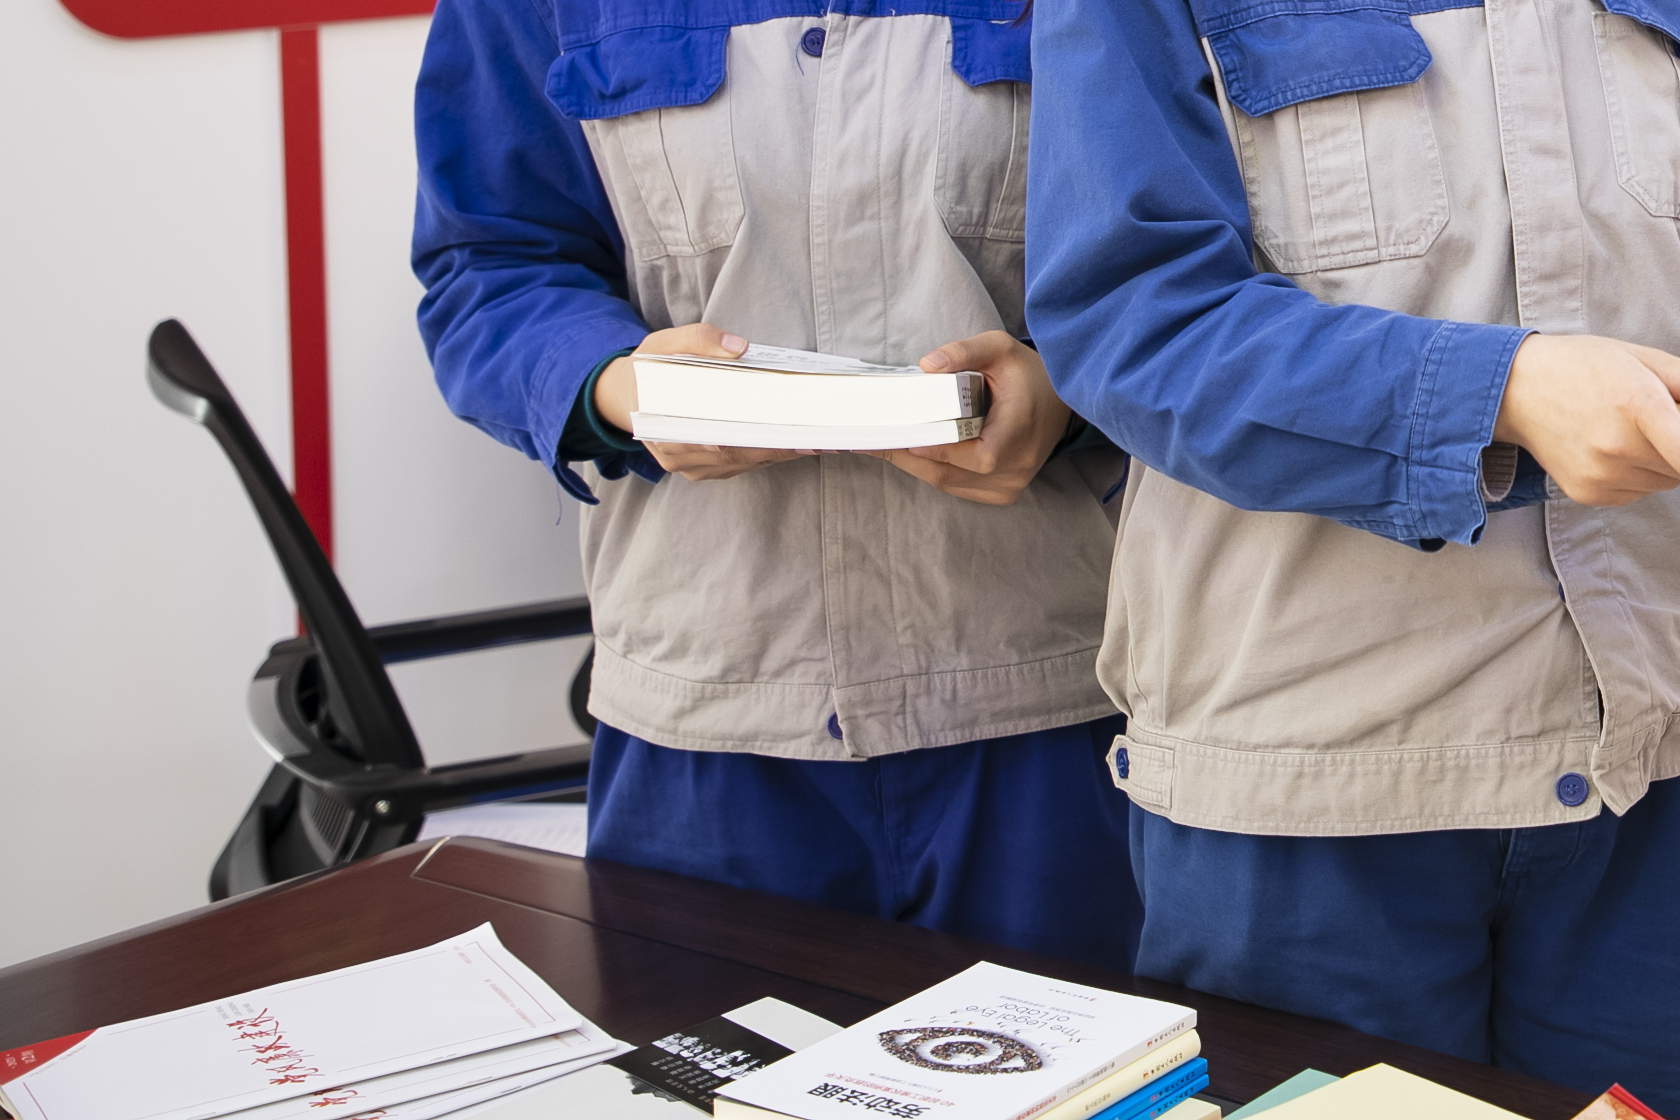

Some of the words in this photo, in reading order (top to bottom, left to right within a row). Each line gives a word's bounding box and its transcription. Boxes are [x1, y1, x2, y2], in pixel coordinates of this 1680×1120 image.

[965, 1005, 998, 1018] Eye
[997, 1002, 1050, 1019] Labor
[996, 1013, 1048, 1029] Legal
[1047, 1014, 1070, 1023] of
[1050, 1024, 1080, 1036] The
[806, 1082, 931, 1119] 劳动法眼
